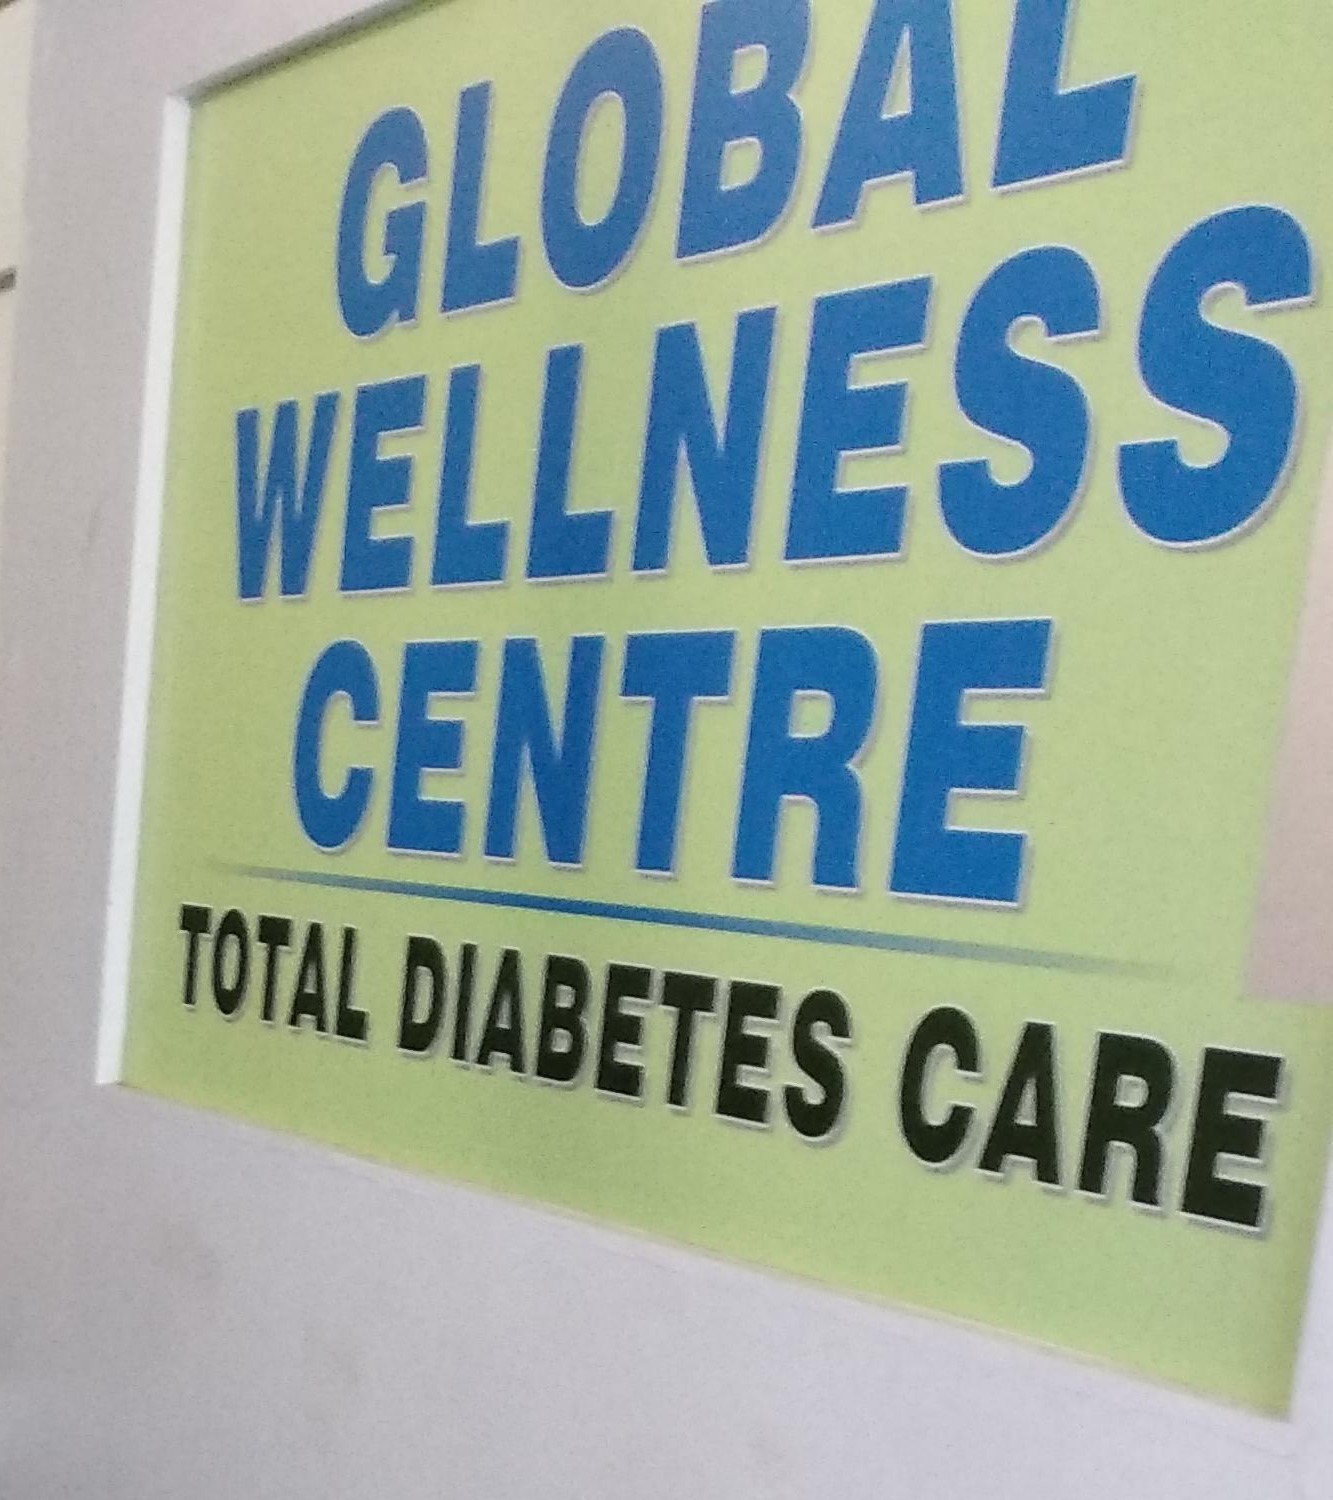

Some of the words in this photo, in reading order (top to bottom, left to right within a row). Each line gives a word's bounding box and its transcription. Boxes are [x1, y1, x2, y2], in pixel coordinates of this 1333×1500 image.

[338, 0, 1136, 339] GLOBAL
[236, 205, 1315, 600] WELLNESS
[294, 619, 1052, 904] CENTRE
[179, 904, 369, 1044] TOTAL
[397, 936, 851, 1140] DIABETES
[899, 1006, 1285, 1230] CARE
